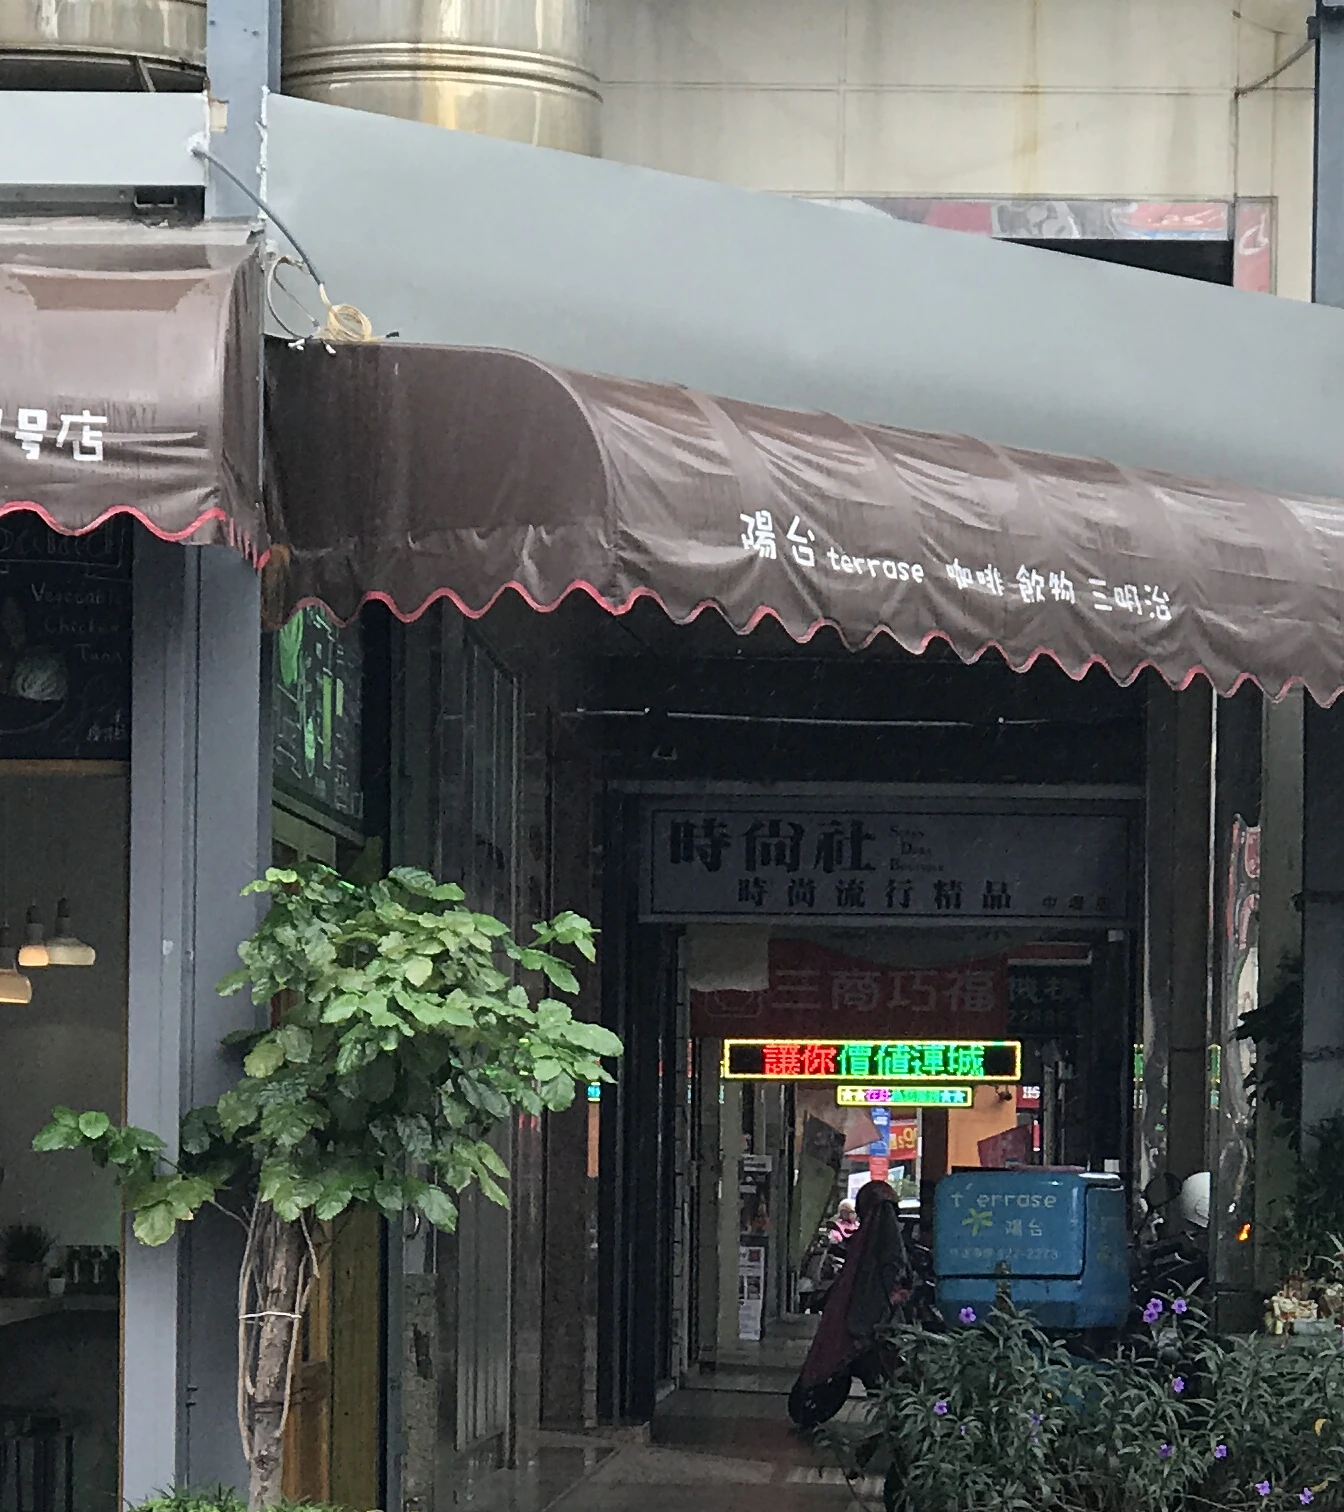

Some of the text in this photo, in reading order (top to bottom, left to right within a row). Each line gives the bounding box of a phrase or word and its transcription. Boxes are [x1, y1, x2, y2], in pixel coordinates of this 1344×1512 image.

[740, 510, 816, 567] 陽台
[827, 545, 925, 583] terrase
[946, 558, 1005, 597] 咖啡
[1088, 577, 1172, 621] 三明治
[670, 818, 876, 873] 時尚社
[737, 878, 1012, 911] 時尚流行精品
[770, 967, 996, 1013] 三商巧福
[762, 1044, 985, 1076] 讓你價值連城
